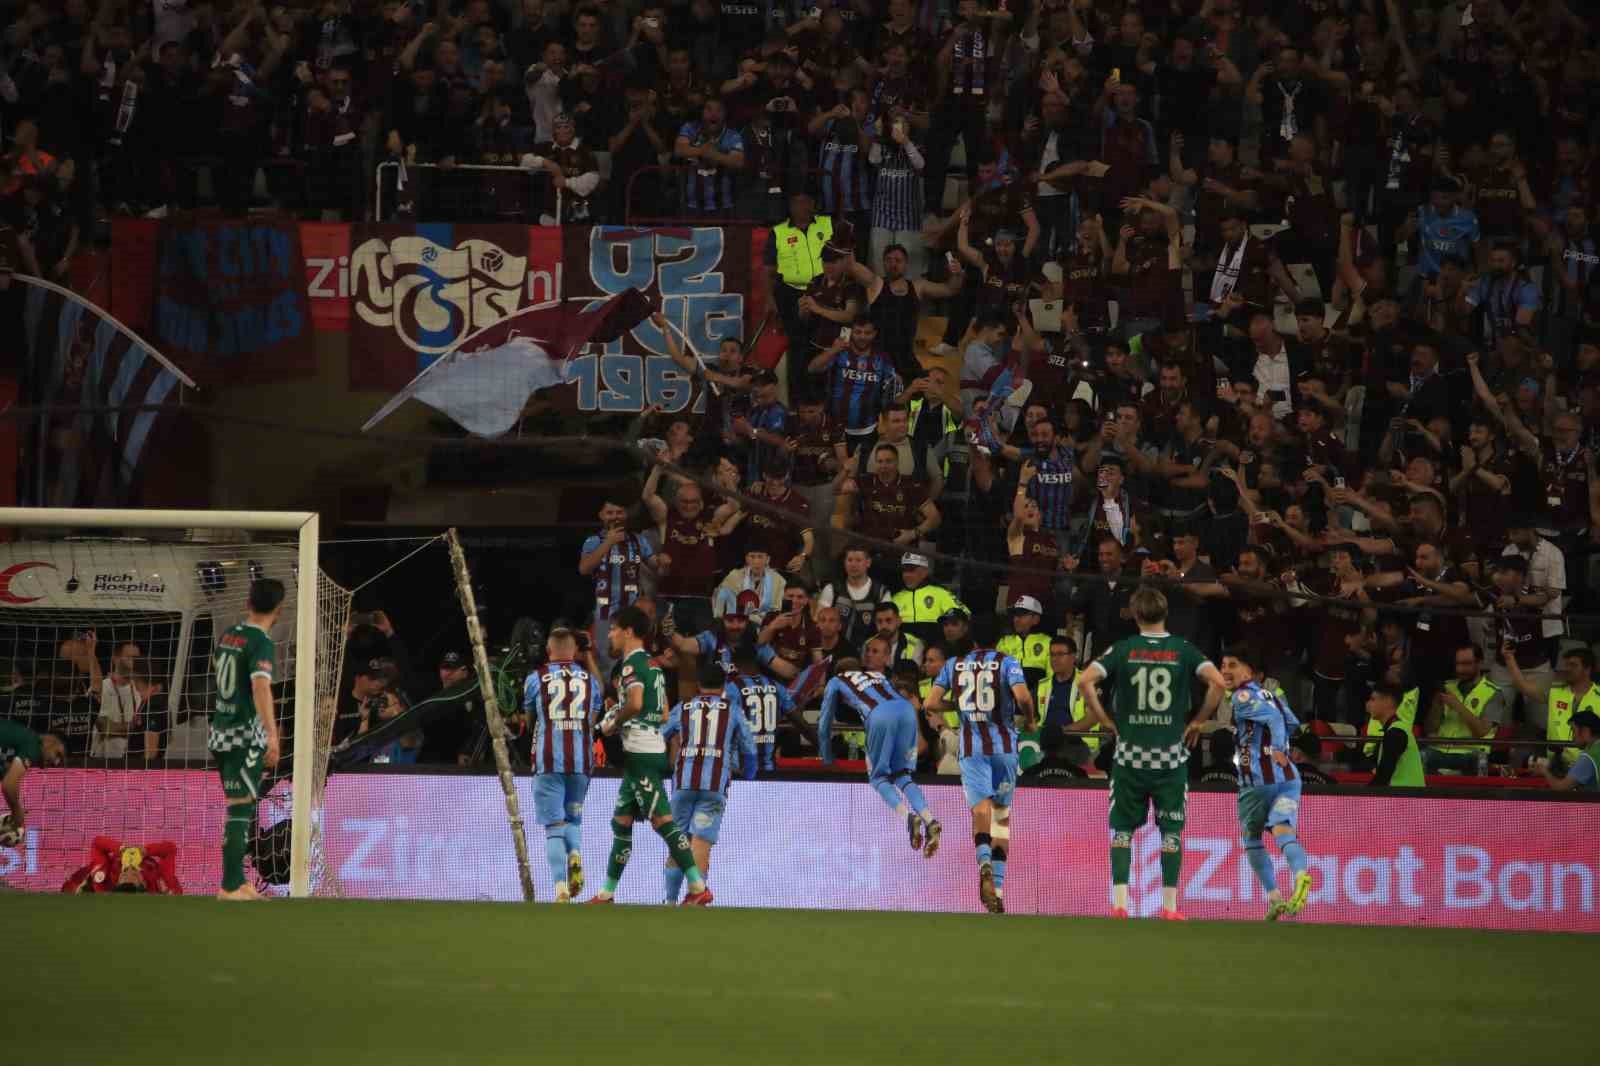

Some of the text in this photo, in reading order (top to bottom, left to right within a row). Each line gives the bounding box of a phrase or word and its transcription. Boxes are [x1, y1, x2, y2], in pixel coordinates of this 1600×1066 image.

[94, 582, 166, 593] Hospital
[95, 573, 133, 583] Rich
[547, 679, 587, 720] 22
[957, 670, 996, 711] 26
[1129, 665, 1173, 712] 18
[690, 709, 720, 745] 11
[745, 693, 778, 732] 30
